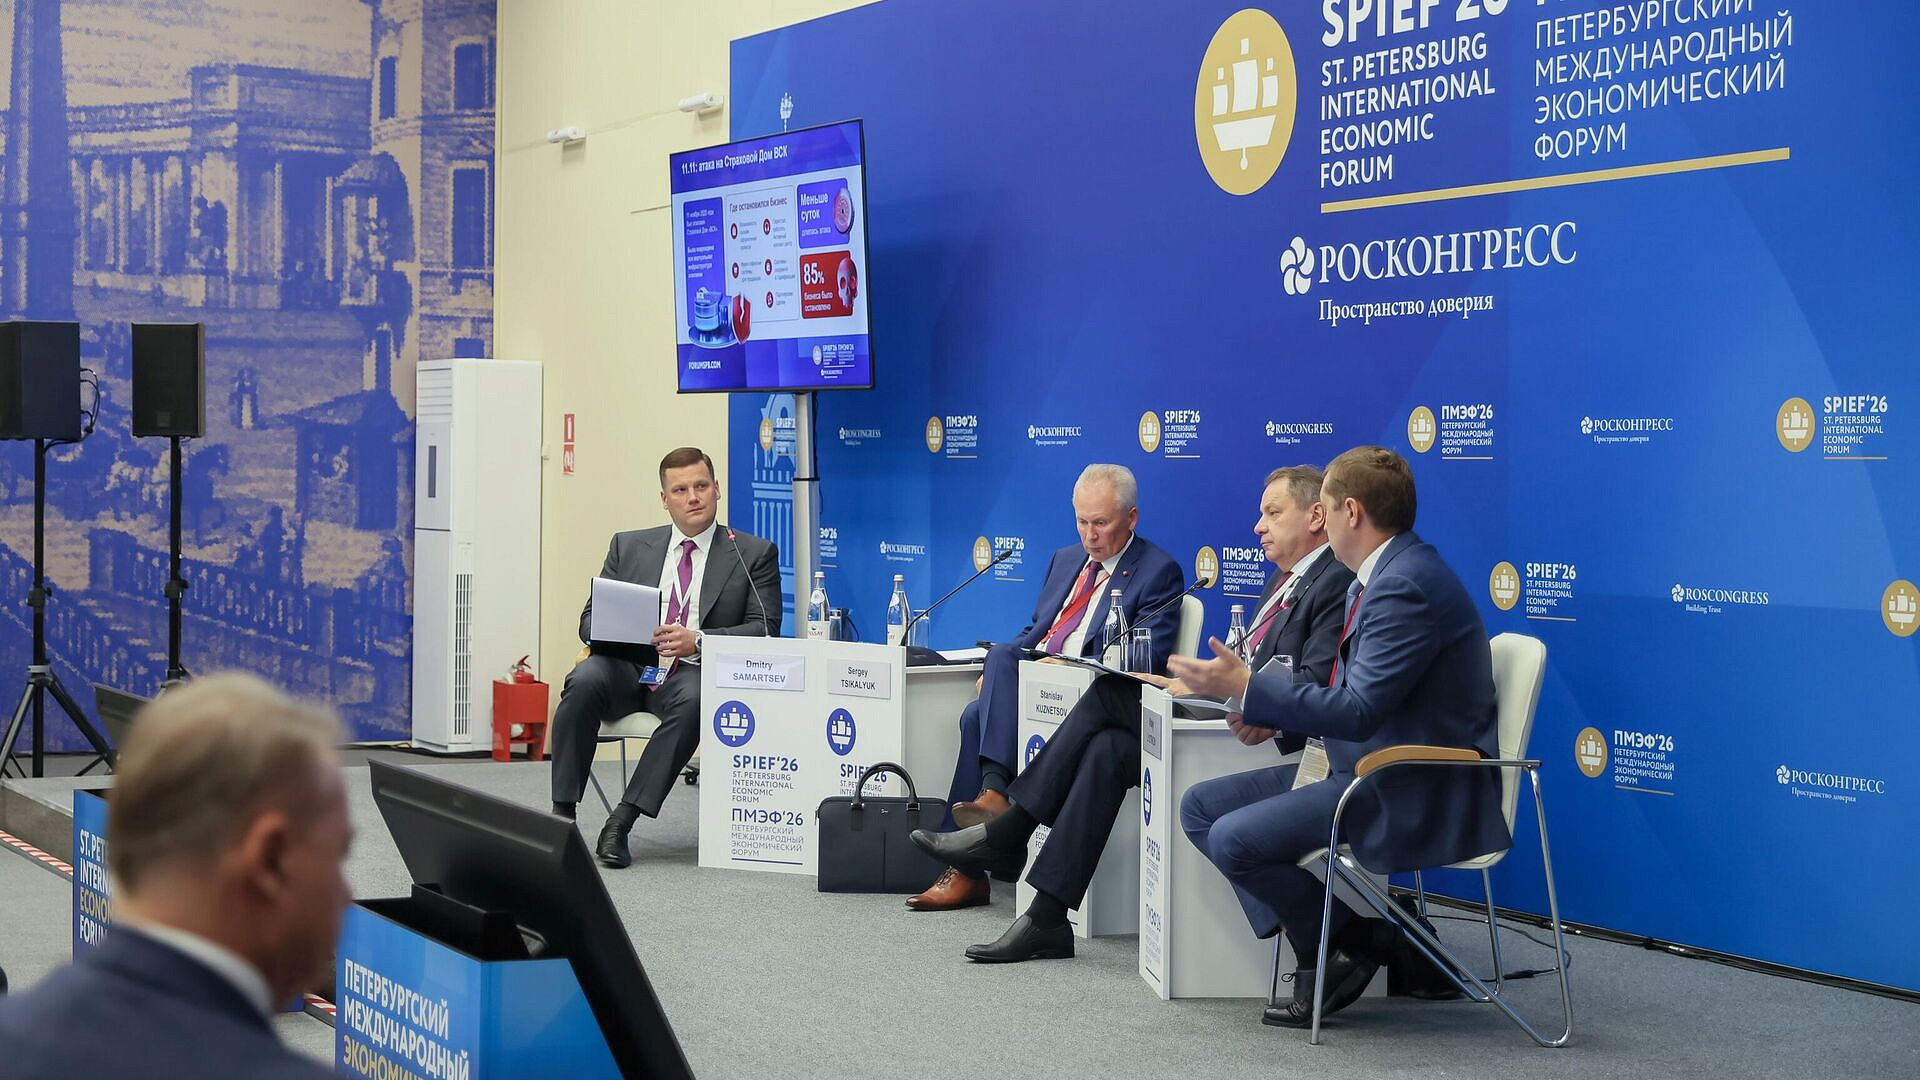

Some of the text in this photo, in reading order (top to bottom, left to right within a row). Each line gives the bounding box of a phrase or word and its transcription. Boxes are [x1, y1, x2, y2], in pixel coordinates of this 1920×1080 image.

[1536, 10, 1792, 86] МЕЖДУНАРОДНЫЙ
[1322, 32, 1487, 86] ST. PETERSBURG
[1321, 68, 1495, 120] INTERNATIONAL
[1534, 52, 1784, 124] ЭКОНОМИЧЕСКИЙ
[1320, 113, 1434, 154] ECONOMIC
[1534, 122, 1626, 160] ФОРУМ
[682, 146, 788, 174] 11.11: атака на Страховой Дом ВСК
[1320, 154, 1393, 188] FORUM
[730, 197, 787, 213] Где остановился бизнес
[801, 193, 828, 206] Меньше
[801, 209, 820, 223] суток
[1319, 222, 1577, 283] РОСКОНГРЕСС
[804, 263, 824, 285] 85%
[1319, 295, 1493, 326] Пространство доверия
[1824, 394, 1888, 413] SPIEF'26
[1165, 410, 1200, 423] SPIEF'26
[1442, 404, 1493, 419] ПМЭФ'26
[946, 415, 977, 427] ПМЭФ'26
[1442, 421, 1486, 429] ПЕТЕРБУРГСКИЙ
[1594, 418, 1673, 431] РОСКОНГРЕСС
[1824, 416, 1880, 424] ST. PETERSBURG
[1036, 427, 1081, 436] РОСКОНГРЕСС
[1275, 423, 1333, 434] ROSCONGRESS
[1442, 429, 1493, 437] МЕЖДУНАРОДНЫЙ
[1824, 426, 1883, 434] INTERNATIONAL
[1442, 438, 1492, 446] ЭКОНОМИЧЕСКИЙ
[820, 528, 837, 539] ЭФ'26
[887, 544, 925, 554] РОСКОНГРЕСС
[995, 537, 1024, 550] SPIEF'26
[1223, 547, 1264, 562] ПМЭФ'26
[1526, 563, 1576, 580] SPIEF'26
[1535, 581, 1570, 589] PETERSBURG
[1526, 589, 1572, 598] INTERNATIONAL
[1686, 588, 1769, 605] ROSCONGRESS
[1526, 598, 1557, 606] ECONOMIC
[1526, 606, 1546, 614] FORUM
[746, 660, 773, 670] Dmitry
[848, 666, 868, 677] Sergey
[733, 673, 785, 682] SAMARTSEV
[841, 680, 875, 690] TSIKALYUK
[1041, 690, 1063, 701] Stanislav
[1036, 704, 1068, 716] KUZNETSOV
[1615, 730, 1674, 752] ПМЭФ'26
[1615, 748, 1666, 760] ПЕТЕРБУРГСКИЙ
[733, 755, 798, 771] SPIEF'26
[1615, 757, 1674, 771] МЕЖДУНАРОДНЫЙ
[744, 772, 791, 780] PETERSBURG
[1615, 766, 1672, 780] ЭКОНОМИЧЕСКИЙ
[733, 779, 794, 789] INTERNATIONAL
[1615, 776, 1637, 784] ФОРУМ
[1792, 770, 1884, 794] РОСКОНГРЕСС
[733, 787, 773, 796] ECONOMIC
[1792, 787, 1832, 798] Пространство
[732, 795, 759, 803] FORUM
[732, 808, 803, 826] ПМЭФ'26
[732, 824, 793, 834] ПЕТЕРБУРГСКИЙ
[80, 829, 90, 856] ST.
[732, 833, 804, 843] МЕЖДУНАРОДНЫЙ
[732, 841, 802, 852] ЭКОНОМИЧЕСКИЙ
[345, 958, 448, 1040] ПЕТЕРБУРГСКИЙ
[345, 995, 469, 1080] МЕЖДУНАРОДНЫЙ
